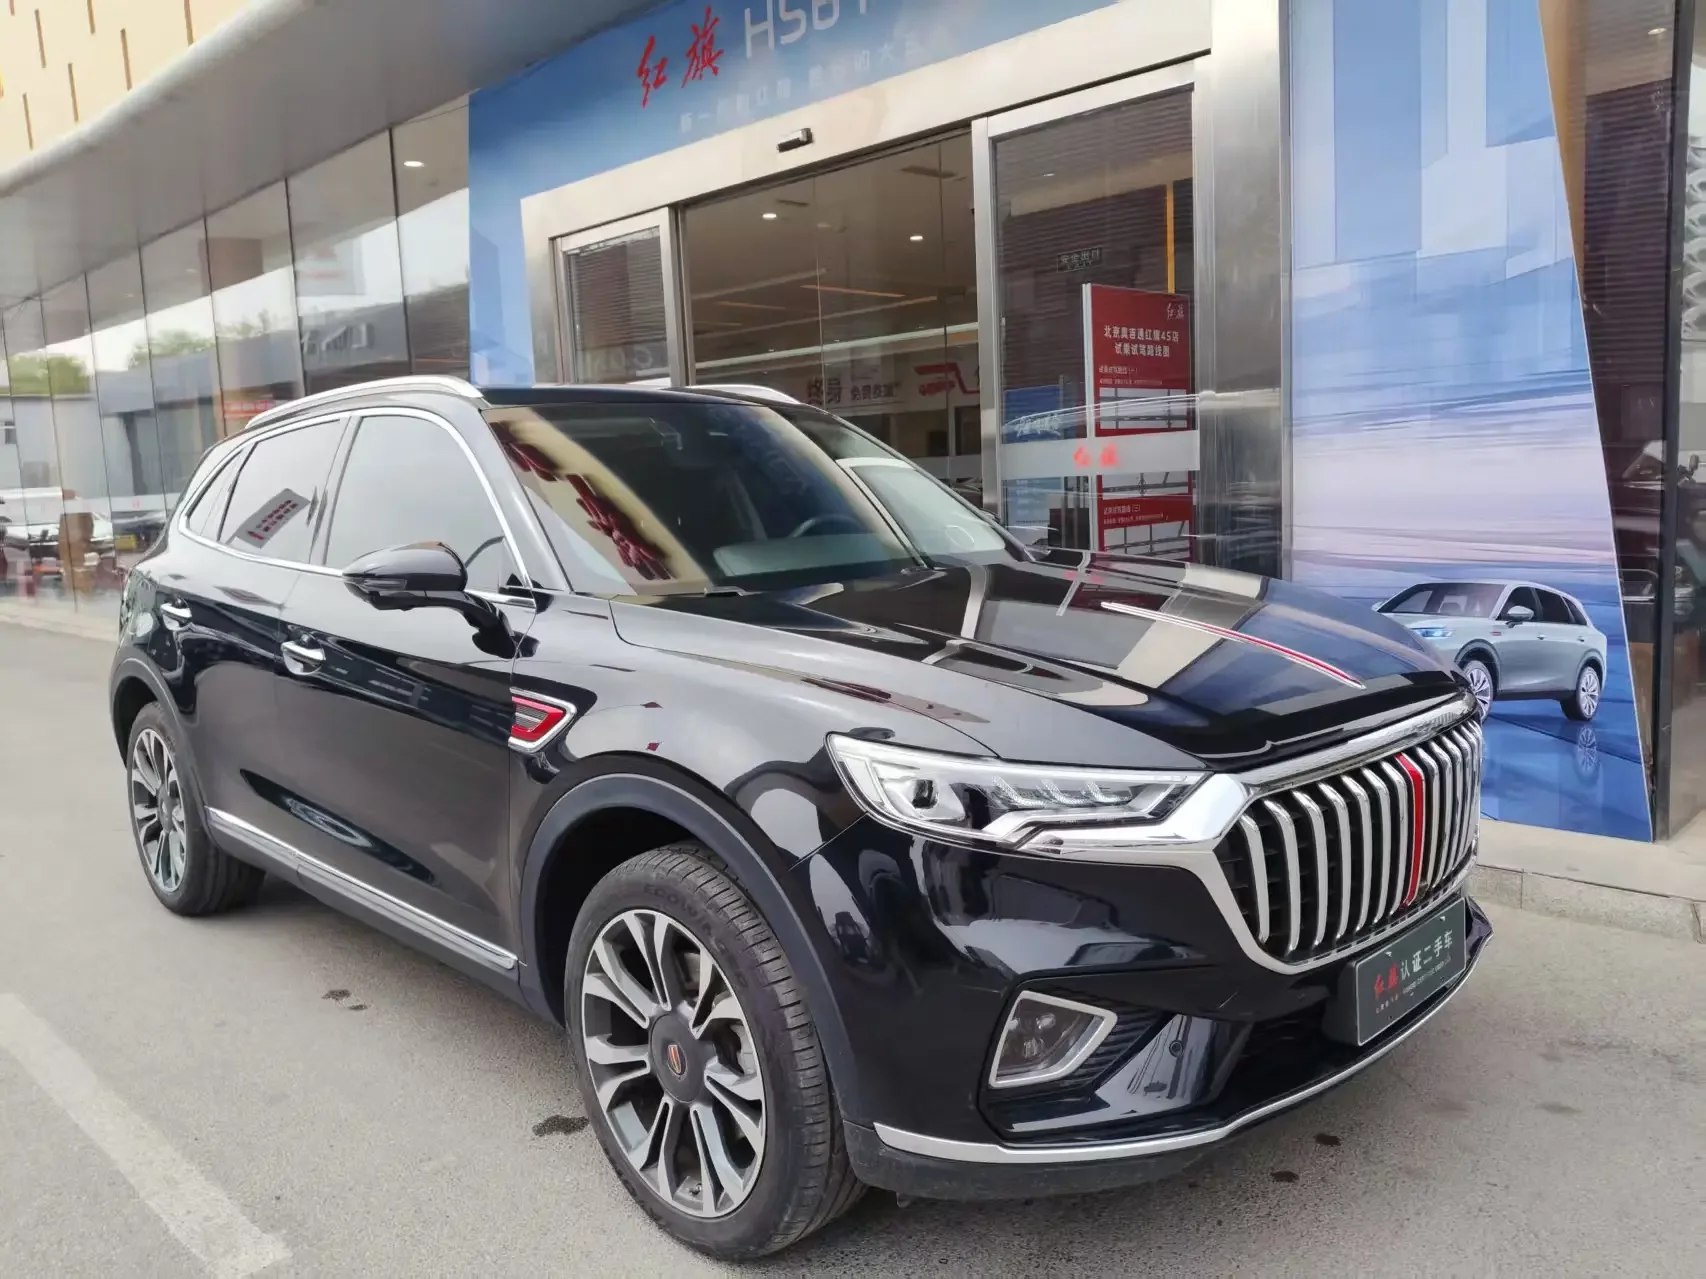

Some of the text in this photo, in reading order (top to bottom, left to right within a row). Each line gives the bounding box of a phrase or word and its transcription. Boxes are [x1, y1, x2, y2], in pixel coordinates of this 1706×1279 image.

[637, 6, 724, 108] 红旗
[1167, 302, 1184, 319] 红旗
[1115, 342, 1170, 357] 试乘试驾路线图
[1400, 930, 1453, 981] 认证二手车
